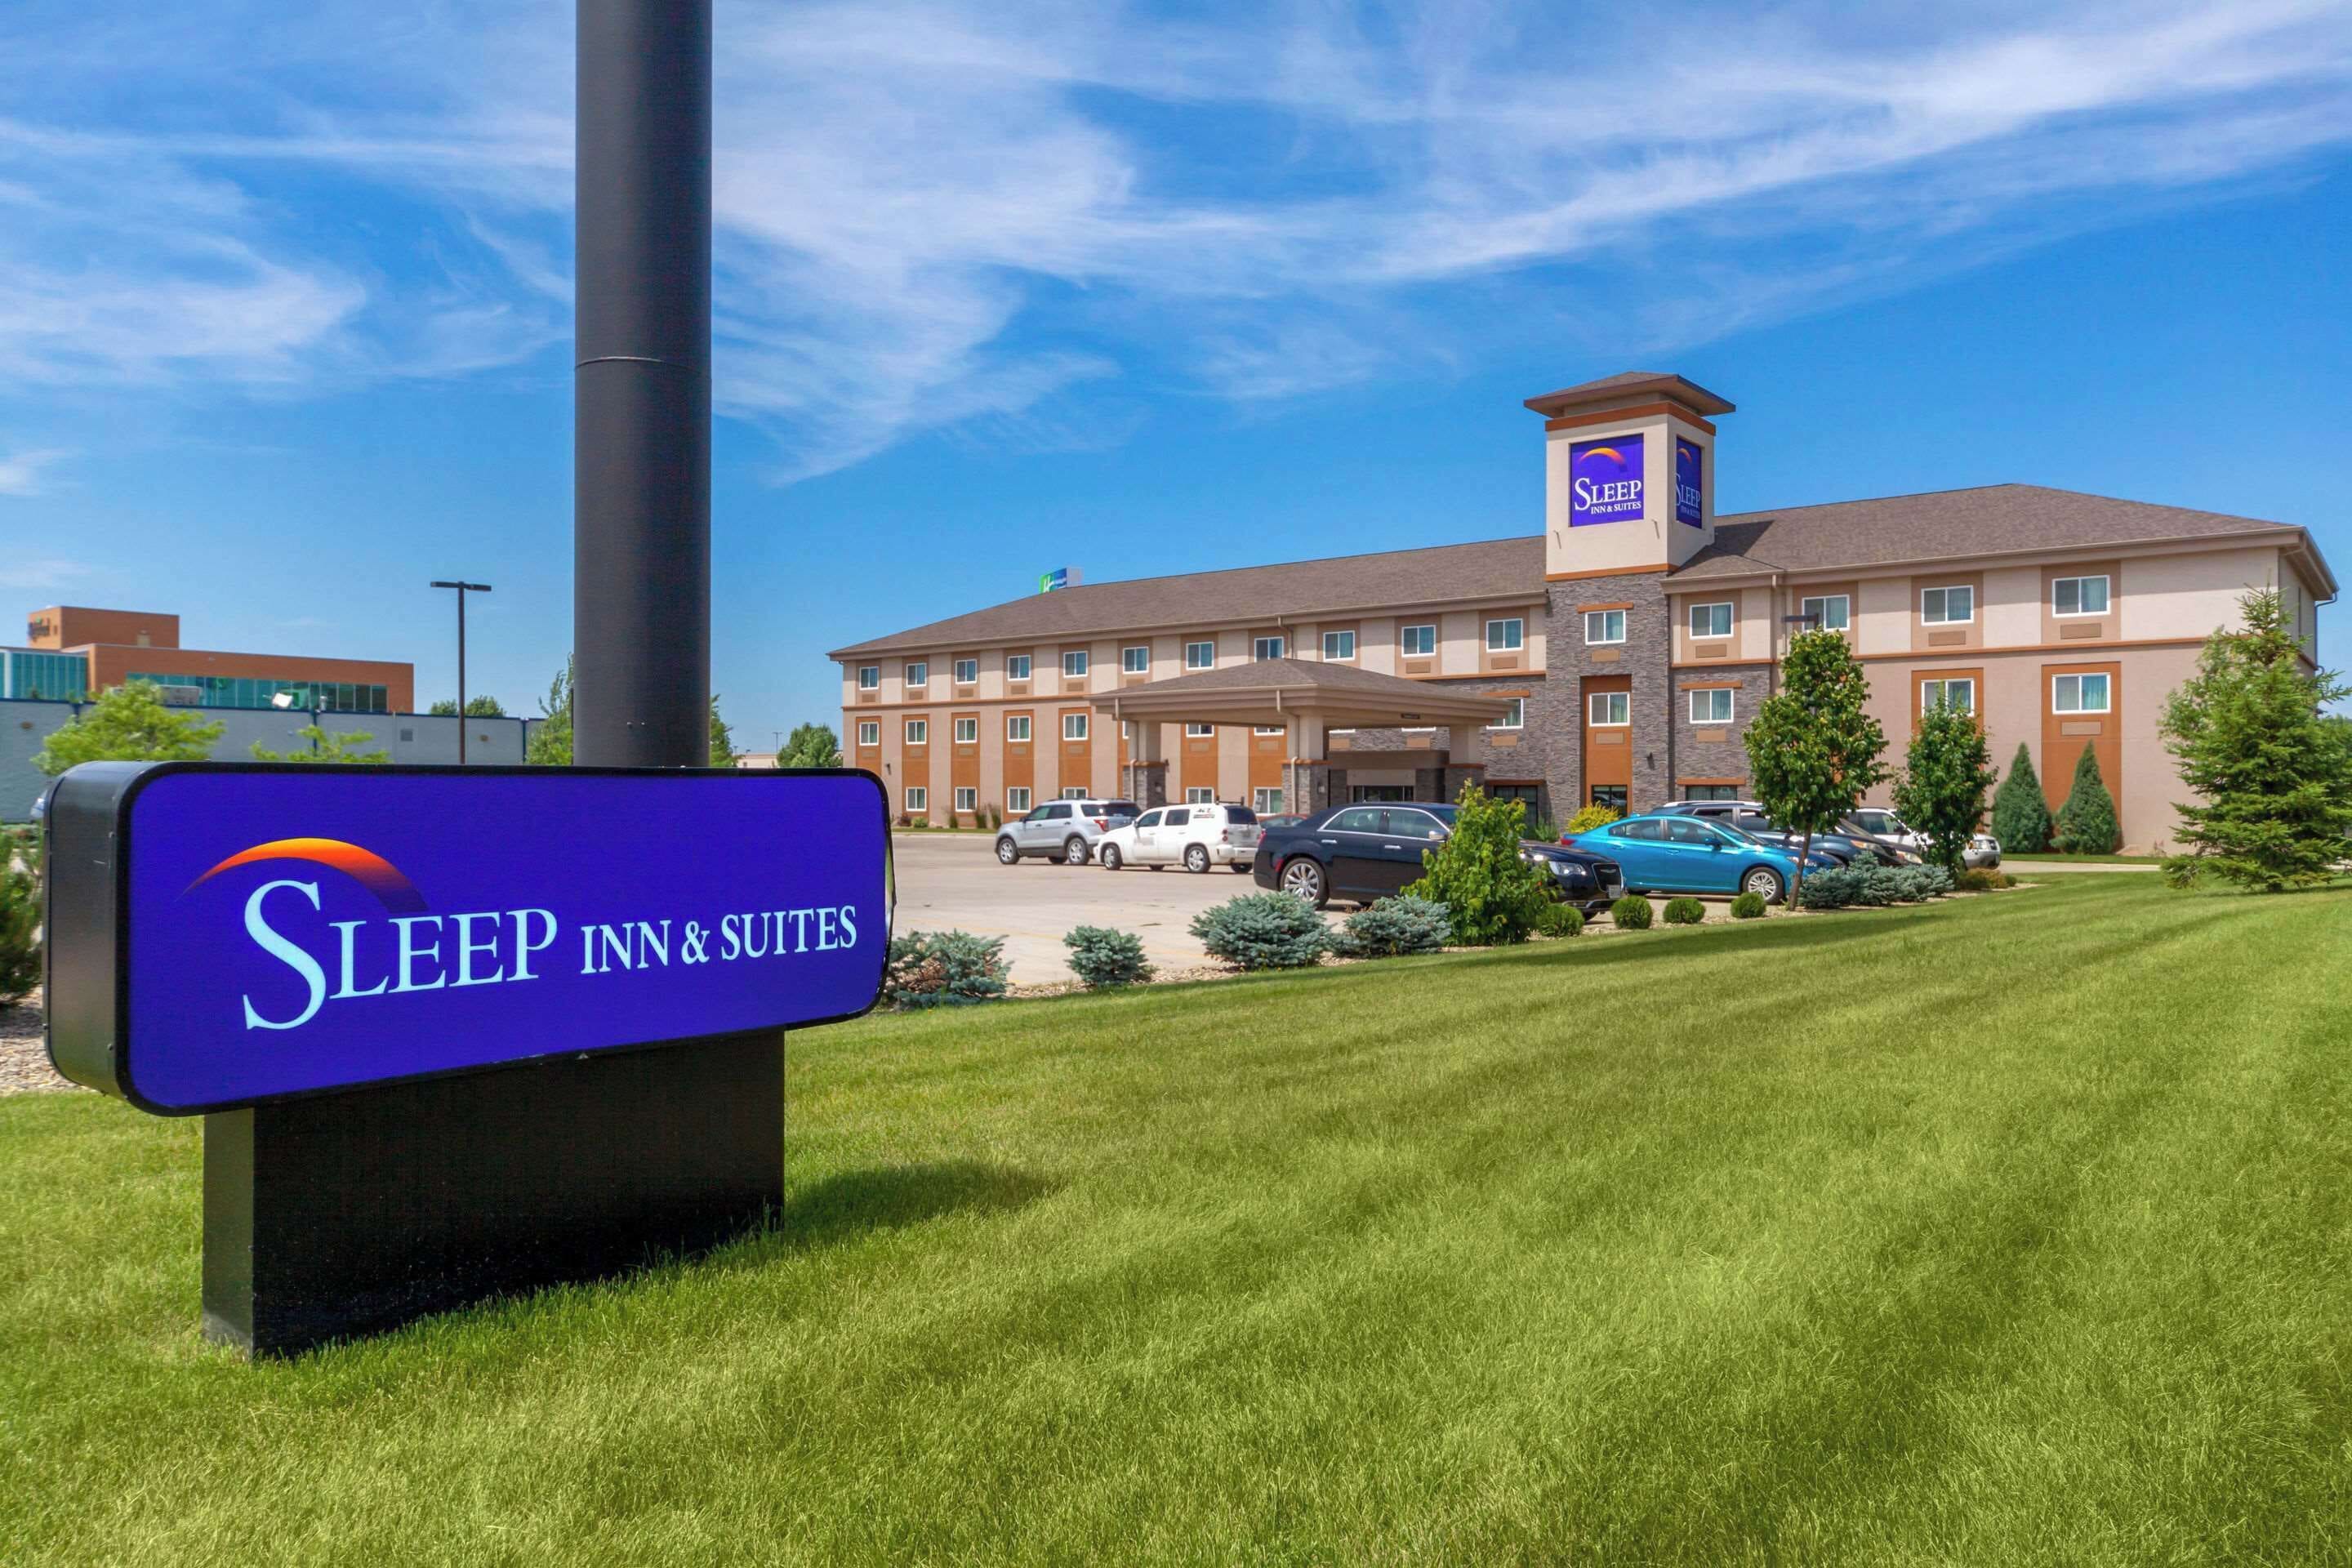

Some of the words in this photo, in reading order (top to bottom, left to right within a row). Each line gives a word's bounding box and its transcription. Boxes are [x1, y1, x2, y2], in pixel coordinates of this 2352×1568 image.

[1575, 478, 1642, 510] SLEEP
[1591, 506, 1606, 514] INN
[1614, 501, 1642, 512] SUITES
[243, 880, 557, 1031] SLEEP
[581, 920, 672, 974] INN
[681, 920, 710, 964] &
[721, 905, 858, 960] SUITES
